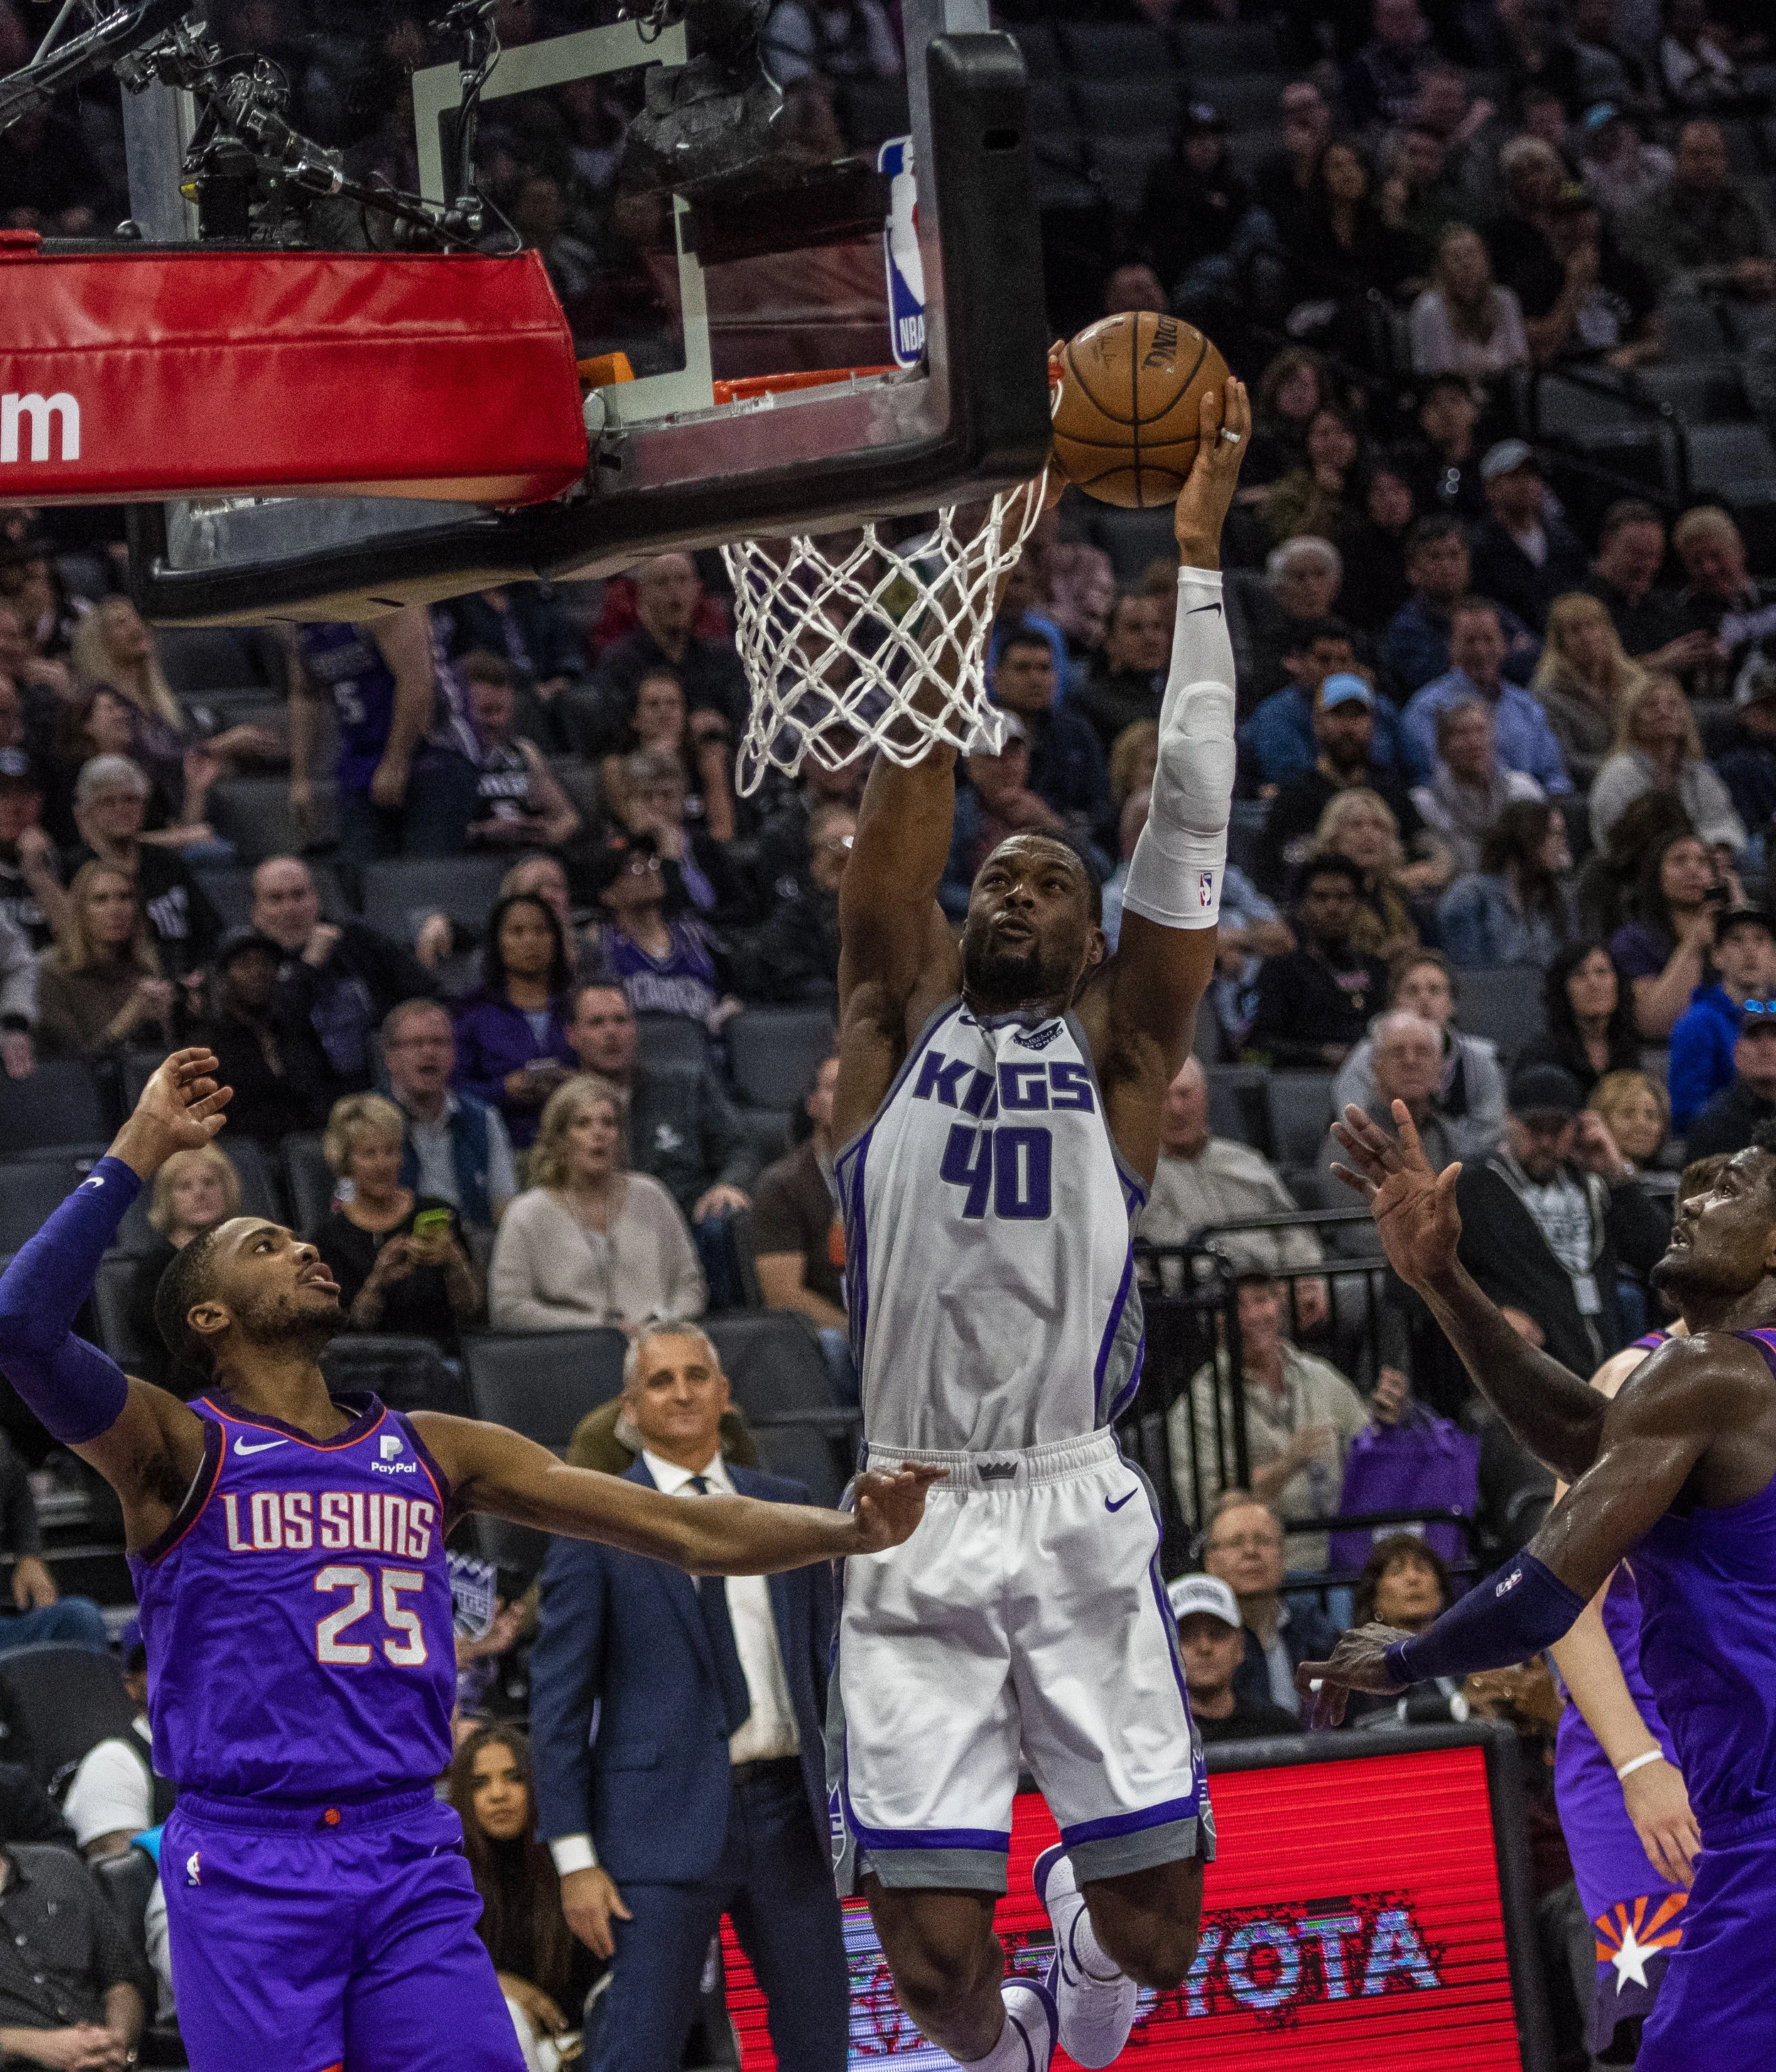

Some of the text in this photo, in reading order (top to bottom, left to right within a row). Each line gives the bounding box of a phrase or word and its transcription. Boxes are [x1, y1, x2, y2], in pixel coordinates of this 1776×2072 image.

[899, 315, 925, 352] NBA
[939, 1122, 1053, 1221] 40
[371, 1462, 416, 1475] PayPal
[217, 1492, 435, 1559] LOS SUNS
[314, 1565, 428, 1666] 25
